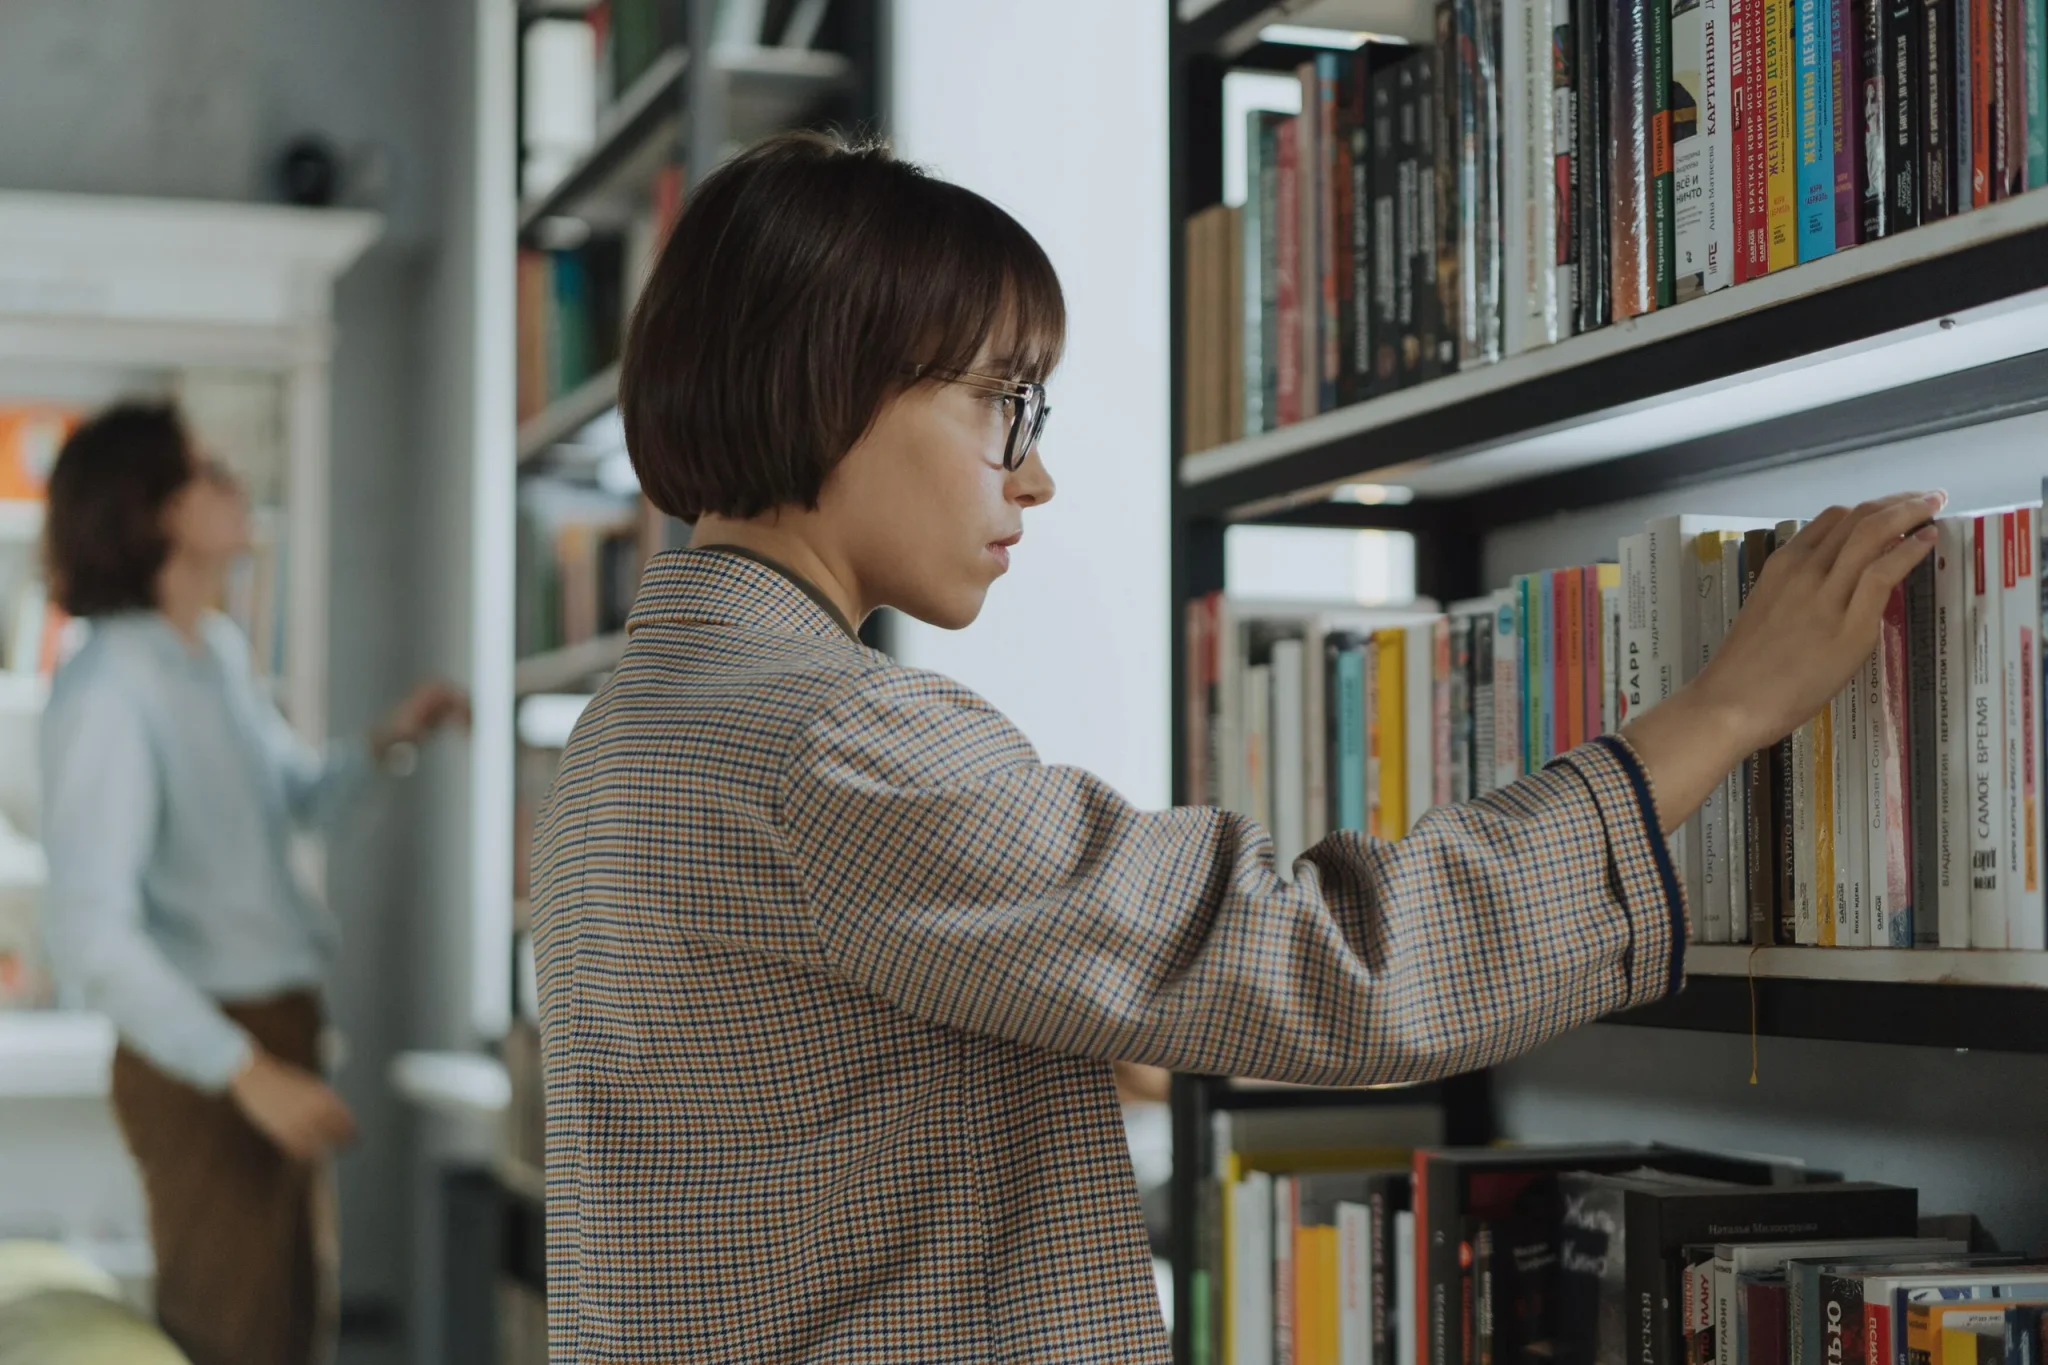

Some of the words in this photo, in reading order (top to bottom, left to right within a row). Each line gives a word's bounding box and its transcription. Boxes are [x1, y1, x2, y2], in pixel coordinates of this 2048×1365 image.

[1654, 6, 1663, 44] ДЕНЬГИ
[1731, 19, 1742, 76] ПОСЛЕ
[1766, 3, 1778, 78] ДЕВЯТОЙ
[1654, 57, 1662, 108] ИСКУССТВО
[1705, 19, 1716, 136] КАРТИННЫЕ
[1897, 34, 1907, 85] БРЕЙГЕЛЯ
[1746, 49, 1754, 151] КВИР-ИСТОРИЯ
[1755, 47, 1763, 149] КВИР-ИСТОРИЯ
[1803, 71, 1815, 167] ЖЕНЩИНЫ
[1833, 59, 1843, 154] ЖЕНЩИНЫ
[1899, 100, 1908, 131] БОСХА
[1768, 85, 1779, 177] ЖЕНЩИНЫ
[1899, 133, 1908, 146] ОТ
[1655, 180, 1666, 218] Досси
[1692, 174, 1699, 185] И
[1708, 145, 1716, 199] Матвеева
[1735, 145, 1743, 199] Боровский
[1747, 155, 1756, 214] КРАТКАЯ
[1757, 153, 1765, 213] КРАТКАЯ
[1708, 202, 1716, 231] Анна
[1735, 200, 1743, 253] Александр
[1656, 221, 1665, 282] Пирошка
[1748, 229, 1756, 264] GARAGE
[1758, 227, 1766, 263] GARAGE
[1649, 532, 1658, 605] СОЛОМОН
[1650, 609, 1659, 660] ЭНДРЮ
[1938, 606, 1947, 655] РОССИИ
[1629, 641, 1640, 706] БАРР
[1870, 648, 1879, 689] фото
[1870, 693, 1878, 704] О
[1938, 658, 1948, 743] ПЕРЕКРЁСТКИ
[1871, 718, 1880, 769] Сонтаг
[1976, 696, 1988, 763] ВРЕМЯ
[1782, 739, 1793, 819] ГИНЗБУРГ
[1872, 772, 1881, 829] Сьюзен
[1940, 753, 1949, 814] НИКИТИН
[1977, 771, 1989, 839] САМОЕ
[1704, 823, 1716, 884] Озерова
[1784, 823, 1793, 877] КАРЛО
[1941, 816, 1951, 888] ВЛАДИМИР
[1799, 882, 1809, 920] GARAGE
[1836, 882, 1846, 924] GARAGE
[1875, 895, 1883, 931] GARAGE
[1699, 1274, 1709, 1327] ПЛАНУ
